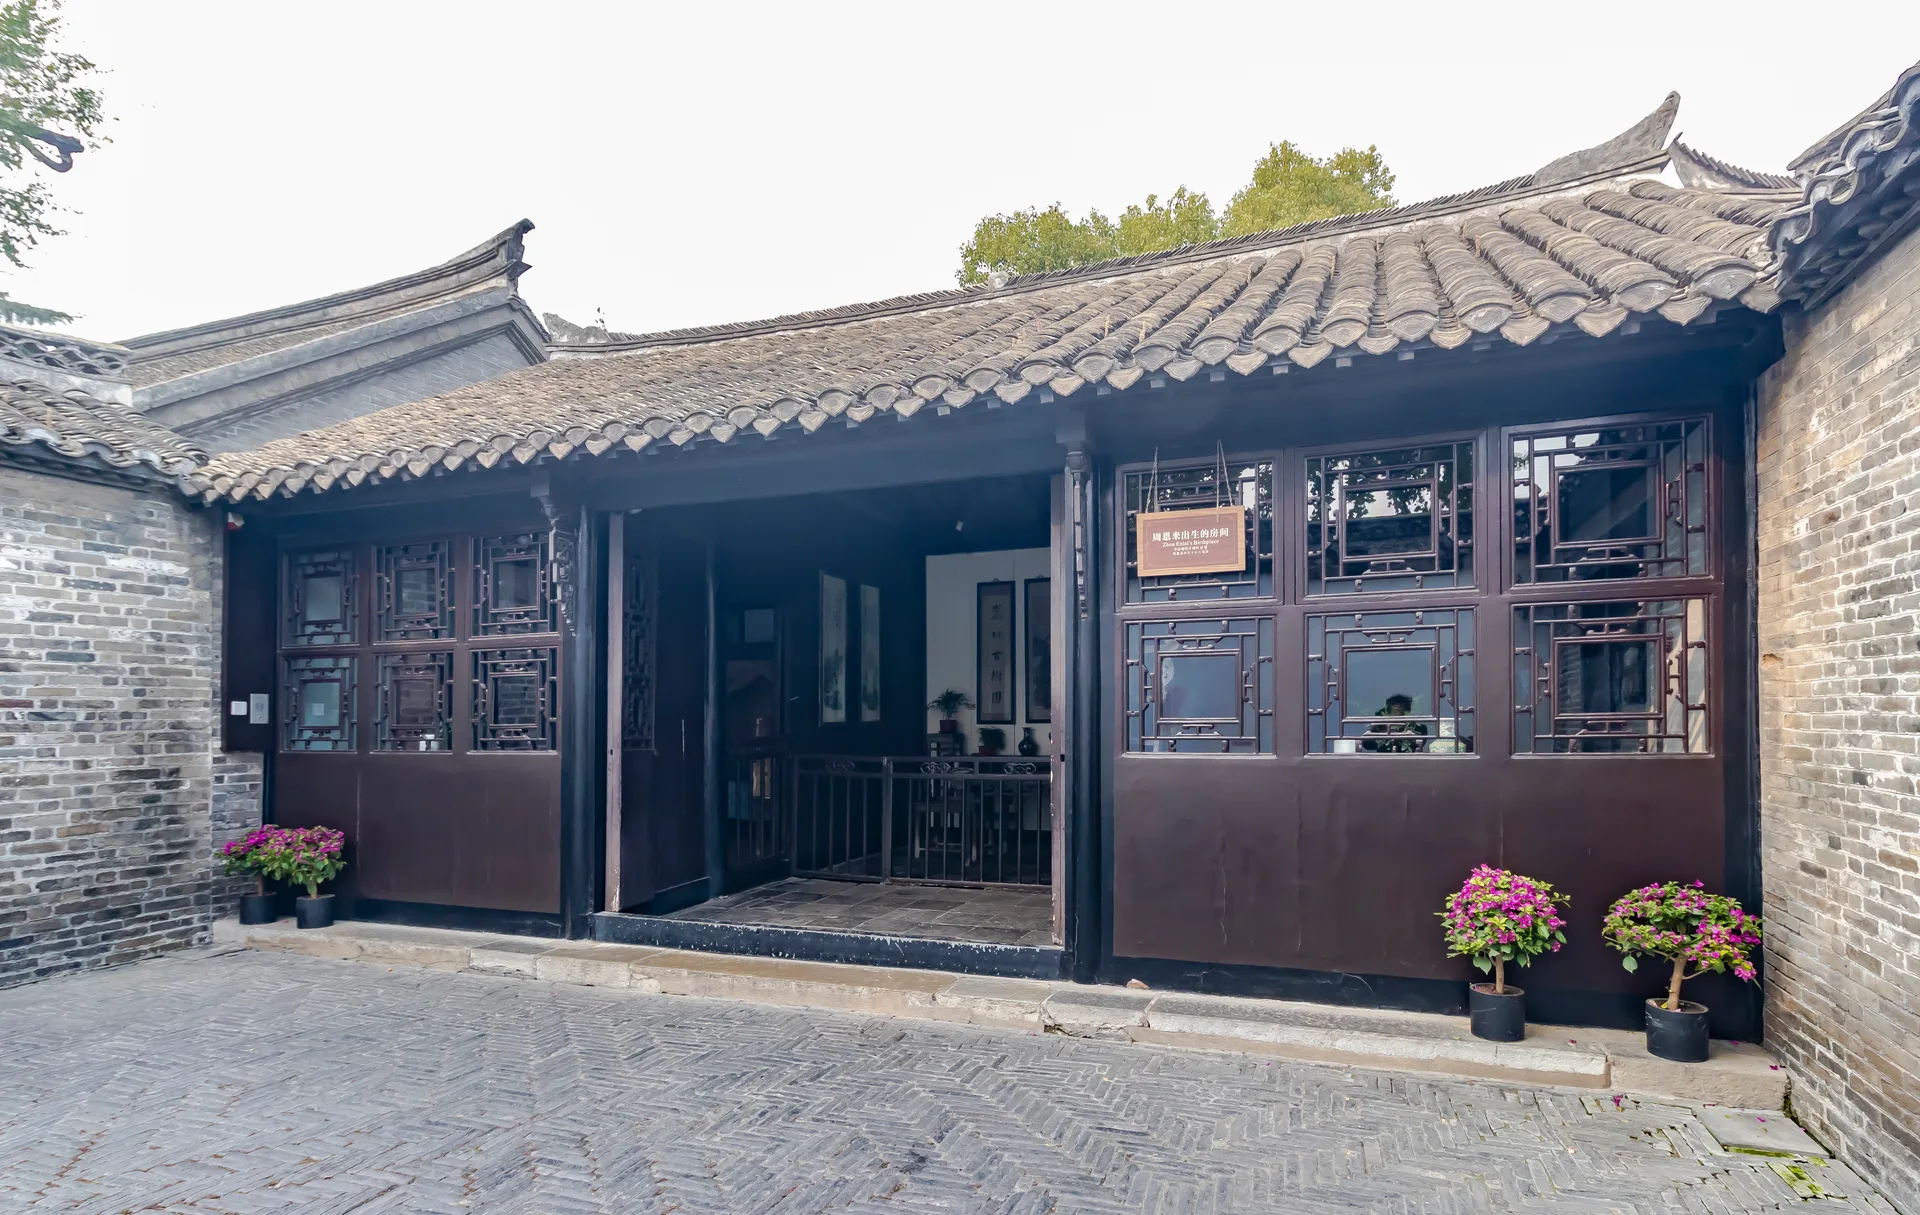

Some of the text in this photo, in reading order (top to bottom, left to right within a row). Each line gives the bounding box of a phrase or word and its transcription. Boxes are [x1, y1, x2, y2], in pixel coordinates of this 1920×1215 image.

[1152, 527, 1229, 542] 周恩来出生的房间
